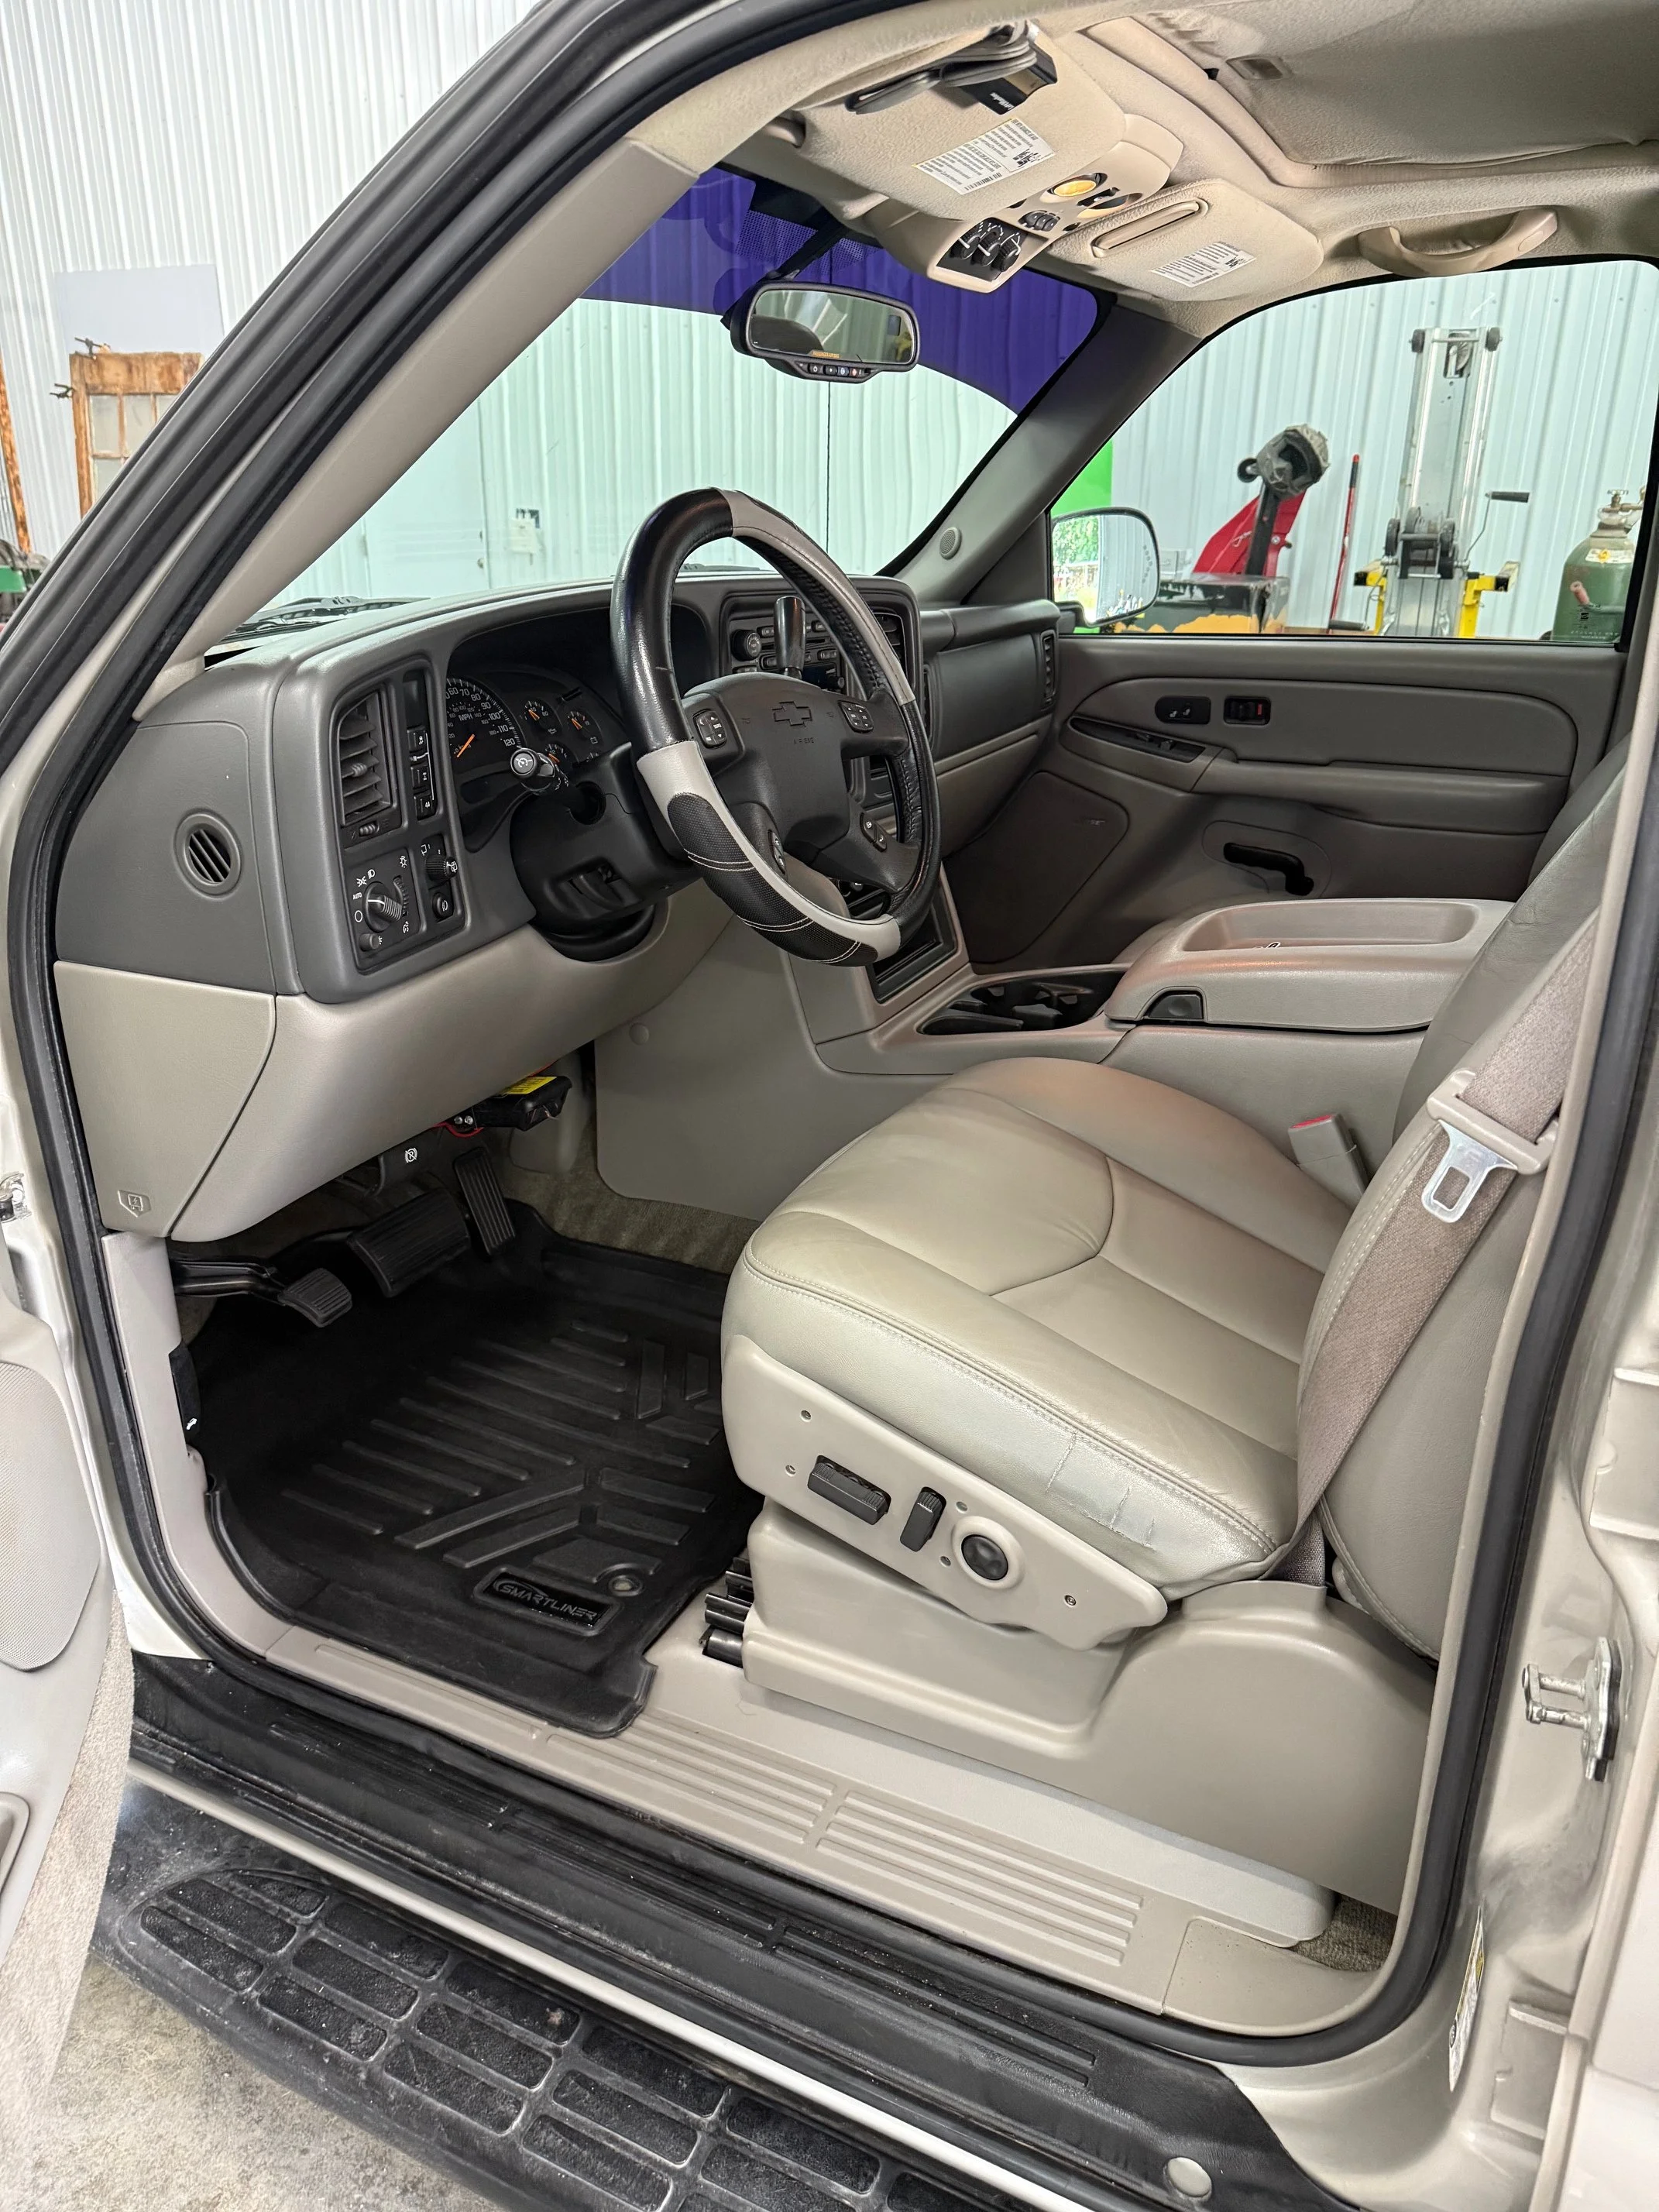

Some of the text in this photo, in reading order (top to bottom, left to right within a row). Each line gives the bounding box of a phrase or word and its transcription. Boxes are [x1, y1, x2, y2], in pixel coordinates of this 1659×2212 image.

[448, 687, 459, 696] 60
[488, 712, 501, 720] 100
[497, 724, 509, 733] 110
[503, 738, 516, 747] 120
[500, 1584, 598, 1621] SMARTLINER
